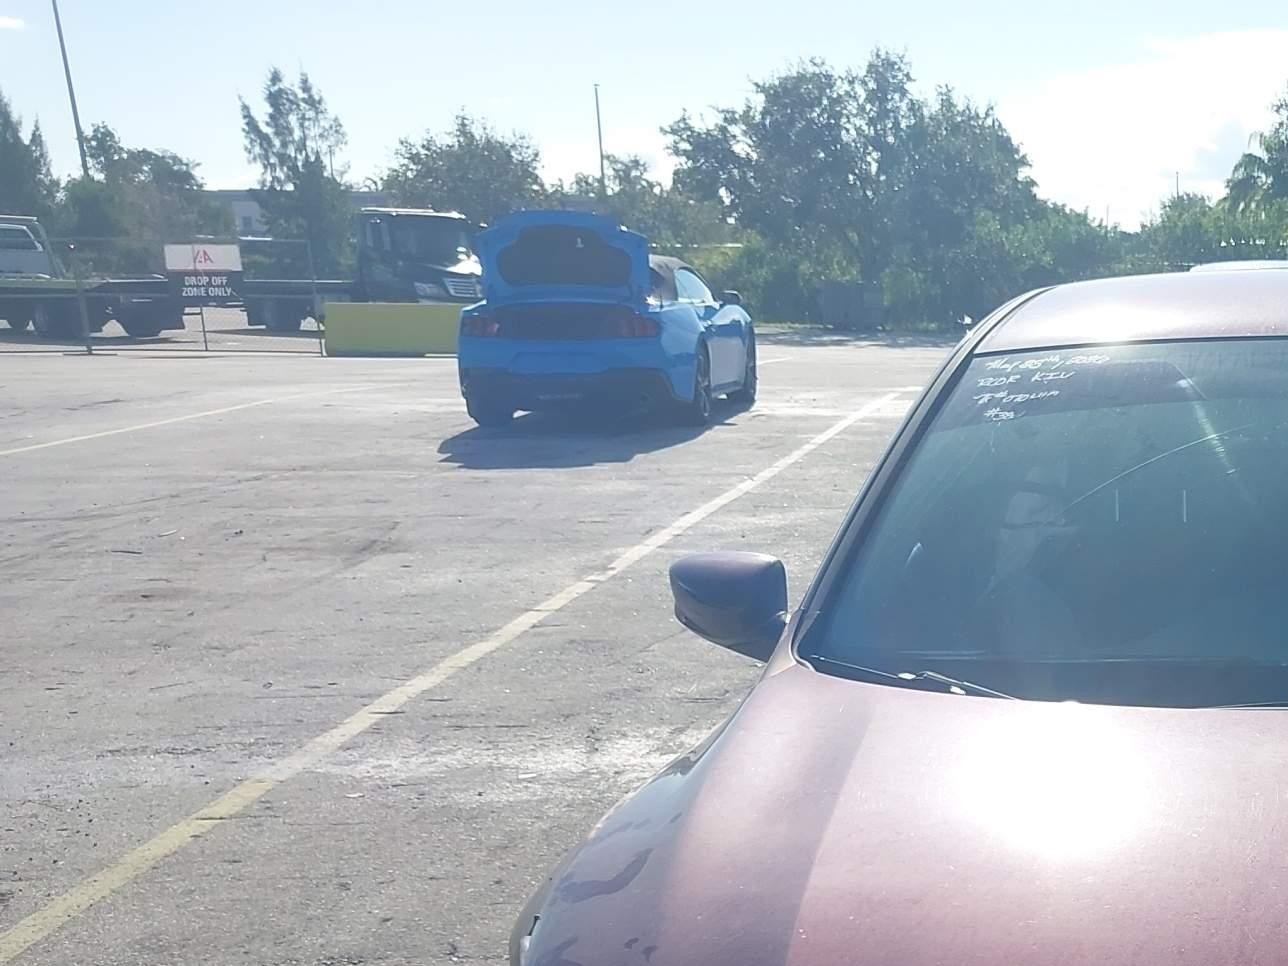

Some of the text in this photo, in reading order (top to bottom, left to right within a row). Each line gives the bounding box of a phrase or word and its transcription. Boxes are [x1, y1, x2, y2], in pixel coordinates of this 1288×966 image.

[184, 276, 227, 286] DROP OFF
[182, 287, 232, 297] ZONE ONLY
